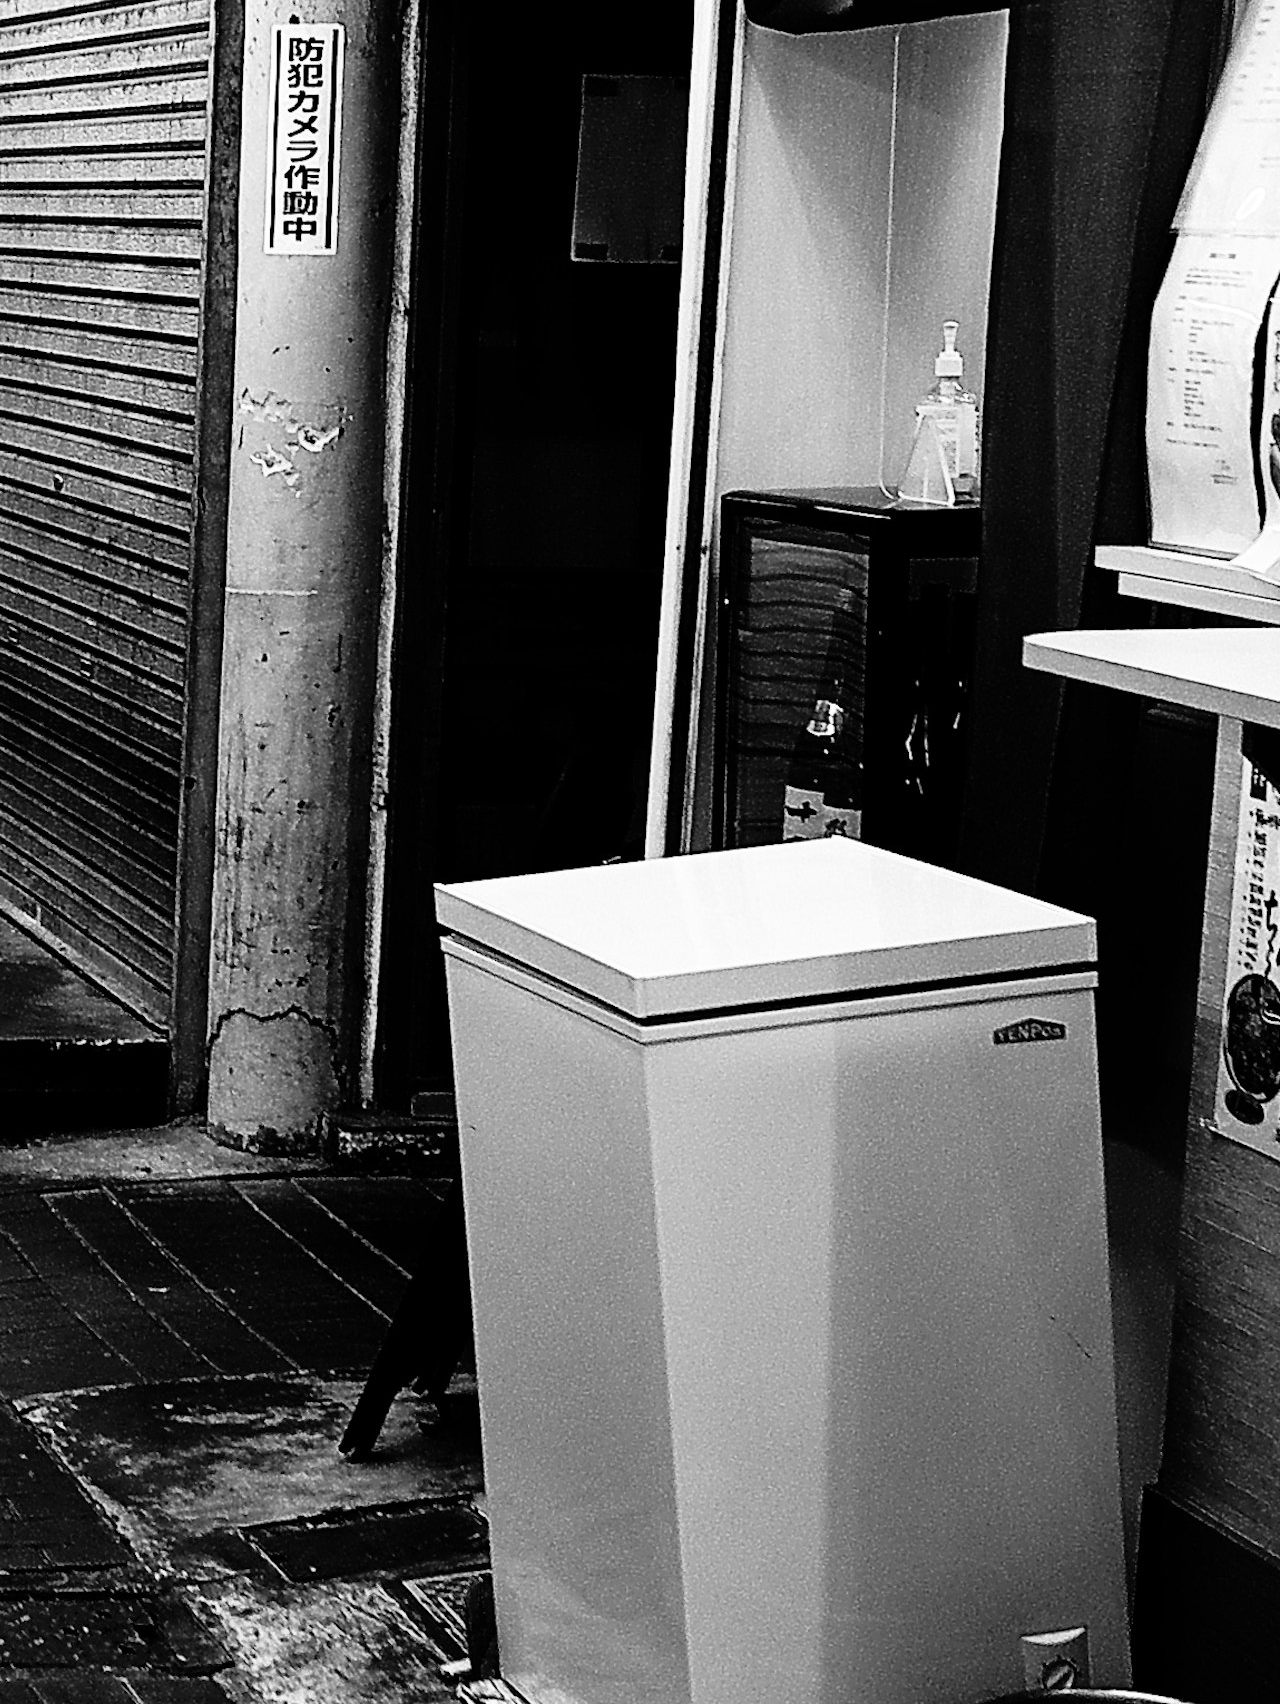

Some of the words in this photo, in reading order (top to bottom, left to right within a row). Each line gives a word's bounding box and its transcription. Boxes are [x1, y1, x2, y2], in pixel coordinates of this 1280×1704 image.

[281, 37, 326, 243] 防犯カメラ作動中
